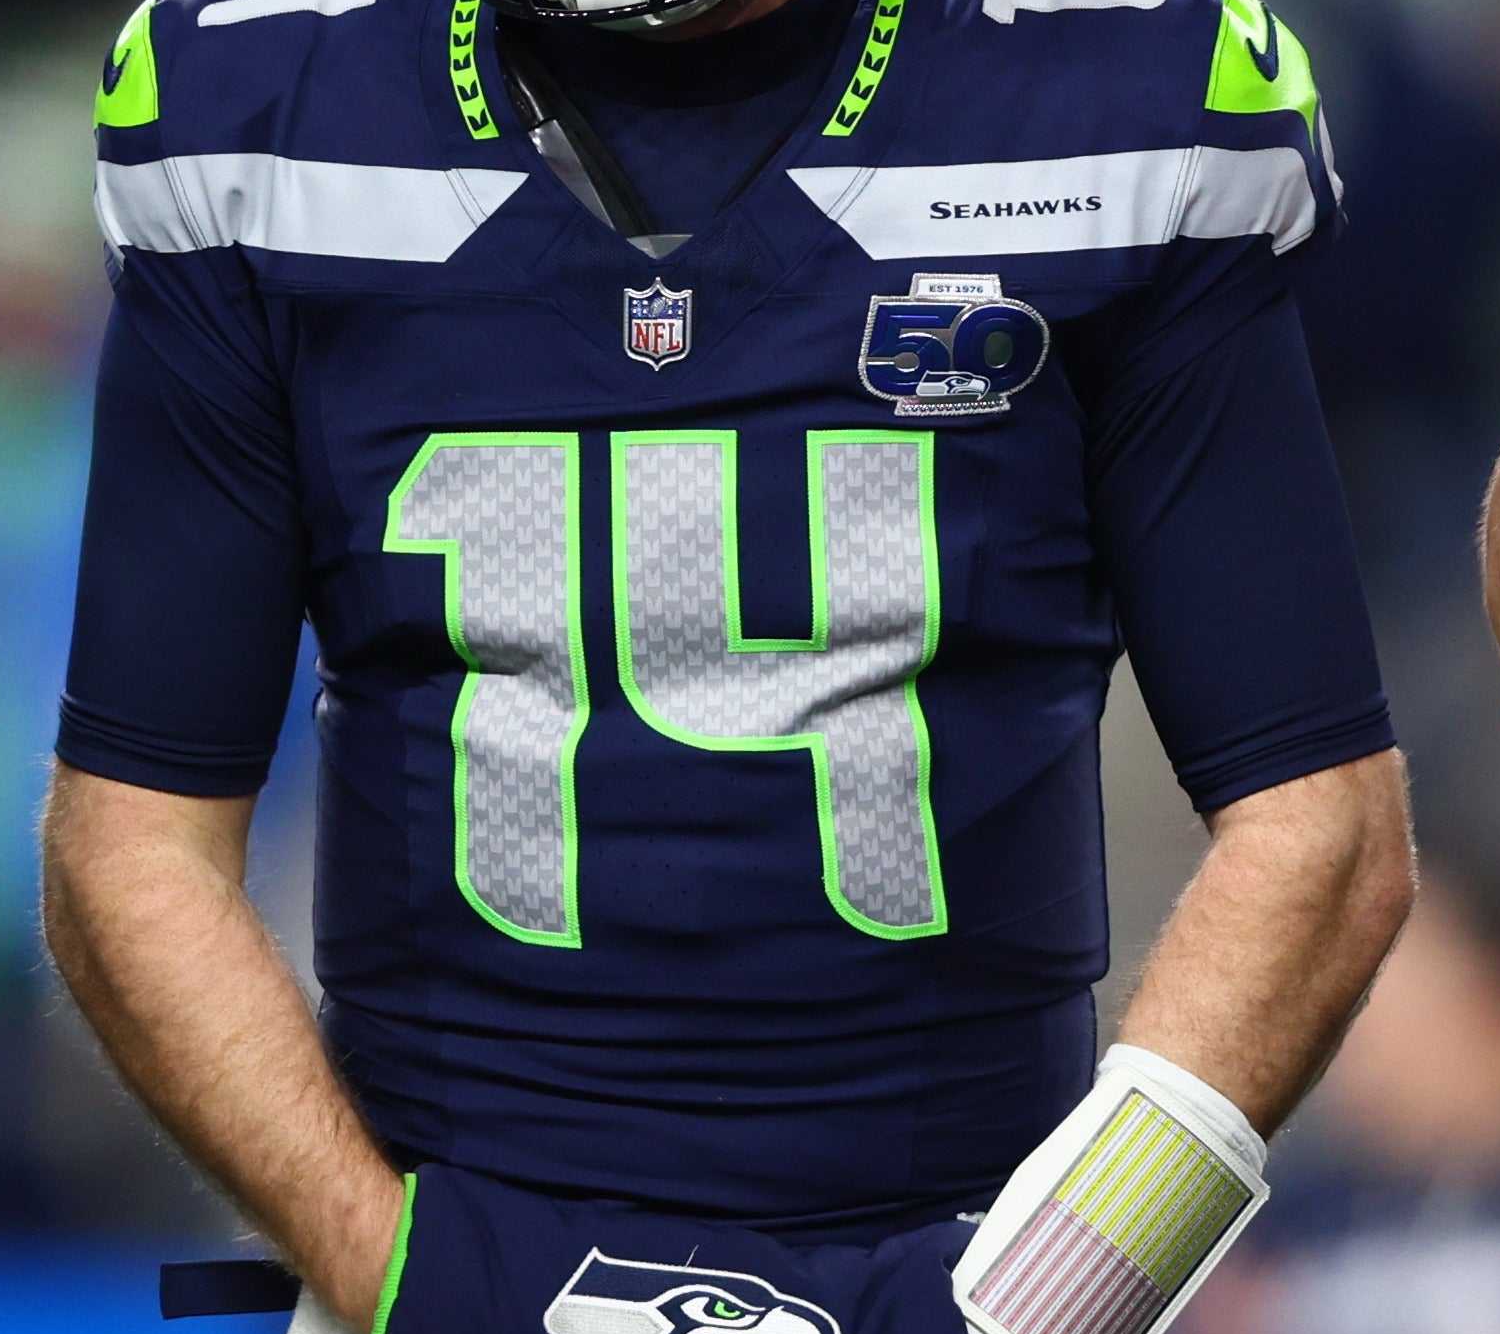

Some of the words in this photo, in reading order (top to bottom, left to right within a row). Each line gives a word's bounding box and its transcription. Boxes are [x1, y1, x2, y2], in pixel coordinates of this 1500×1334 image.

[928, 285, 951, 294] EST
[955, 285, 984, 294] 1976
[634, 322, 681, 355] NFL
[866, 302, 1046, 398] 50
[380, 430, 949, 949] 14
